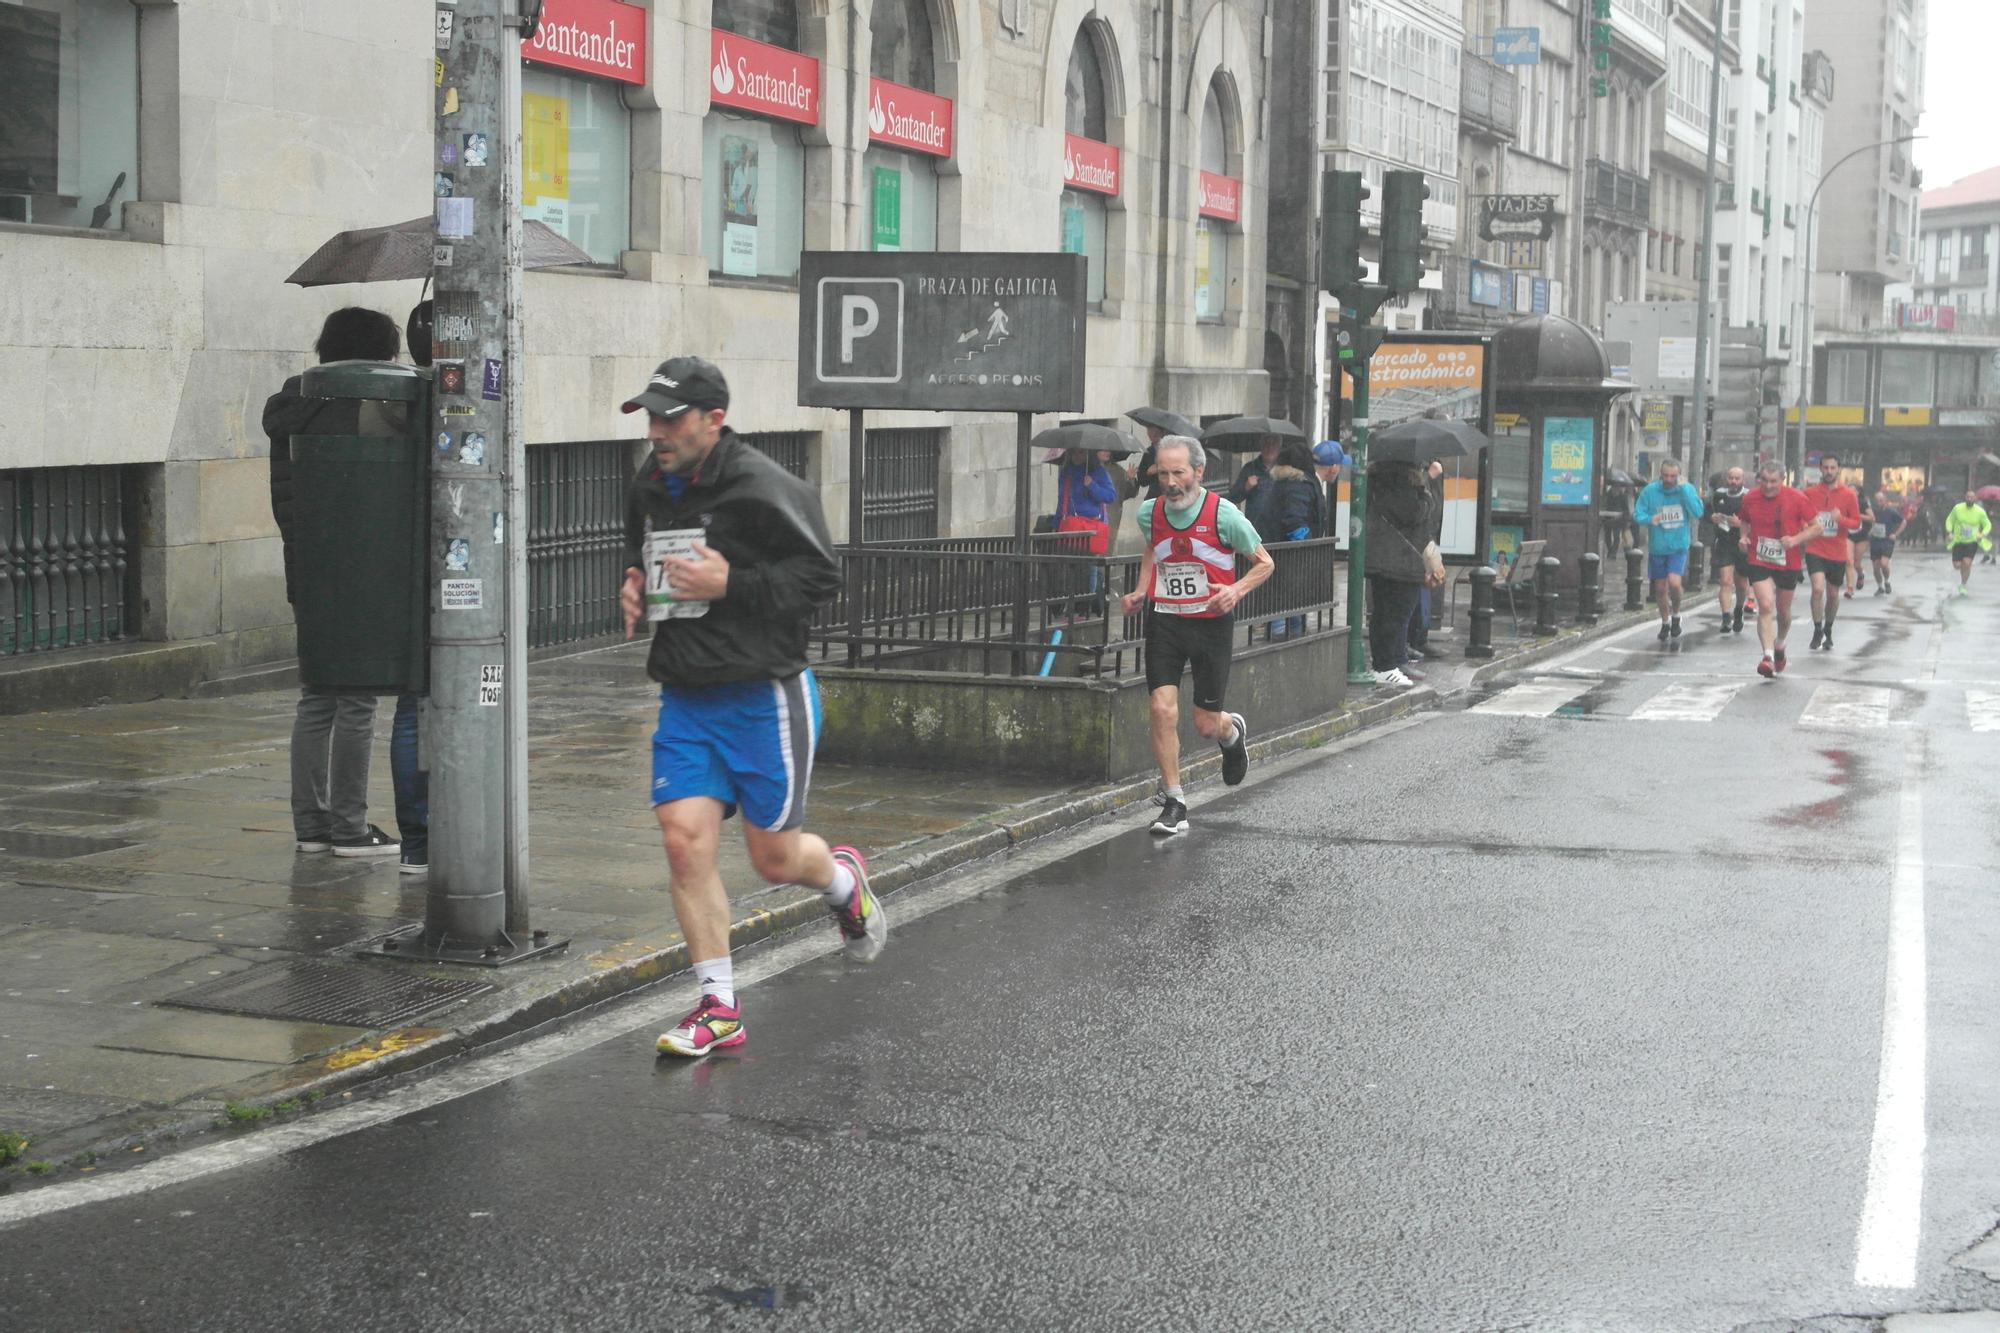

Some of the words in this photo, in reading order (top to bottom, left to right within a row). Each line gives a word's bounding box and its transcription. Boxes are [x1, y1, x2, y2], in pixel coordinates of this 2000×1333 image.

[533, 7, 635, 70] Santander
[737, 57, 812, 111] Santander
[887, 101, 946, 148] Santander
[1075, 154, 1116, 188] Santander
[1206, 184, 1236, 213] Santander
[1487, 199, 1548, 213] VIAJES
[919, 277, 966, 296] PRAZA
[972, 277, 991, 296] DE
[995, 277, 1058, 296] GALICIA
[841, 295, 879, 363] P
[1369, 363, 1476, 382] stronómico
[1551, 442, 1584, 456] BEN
